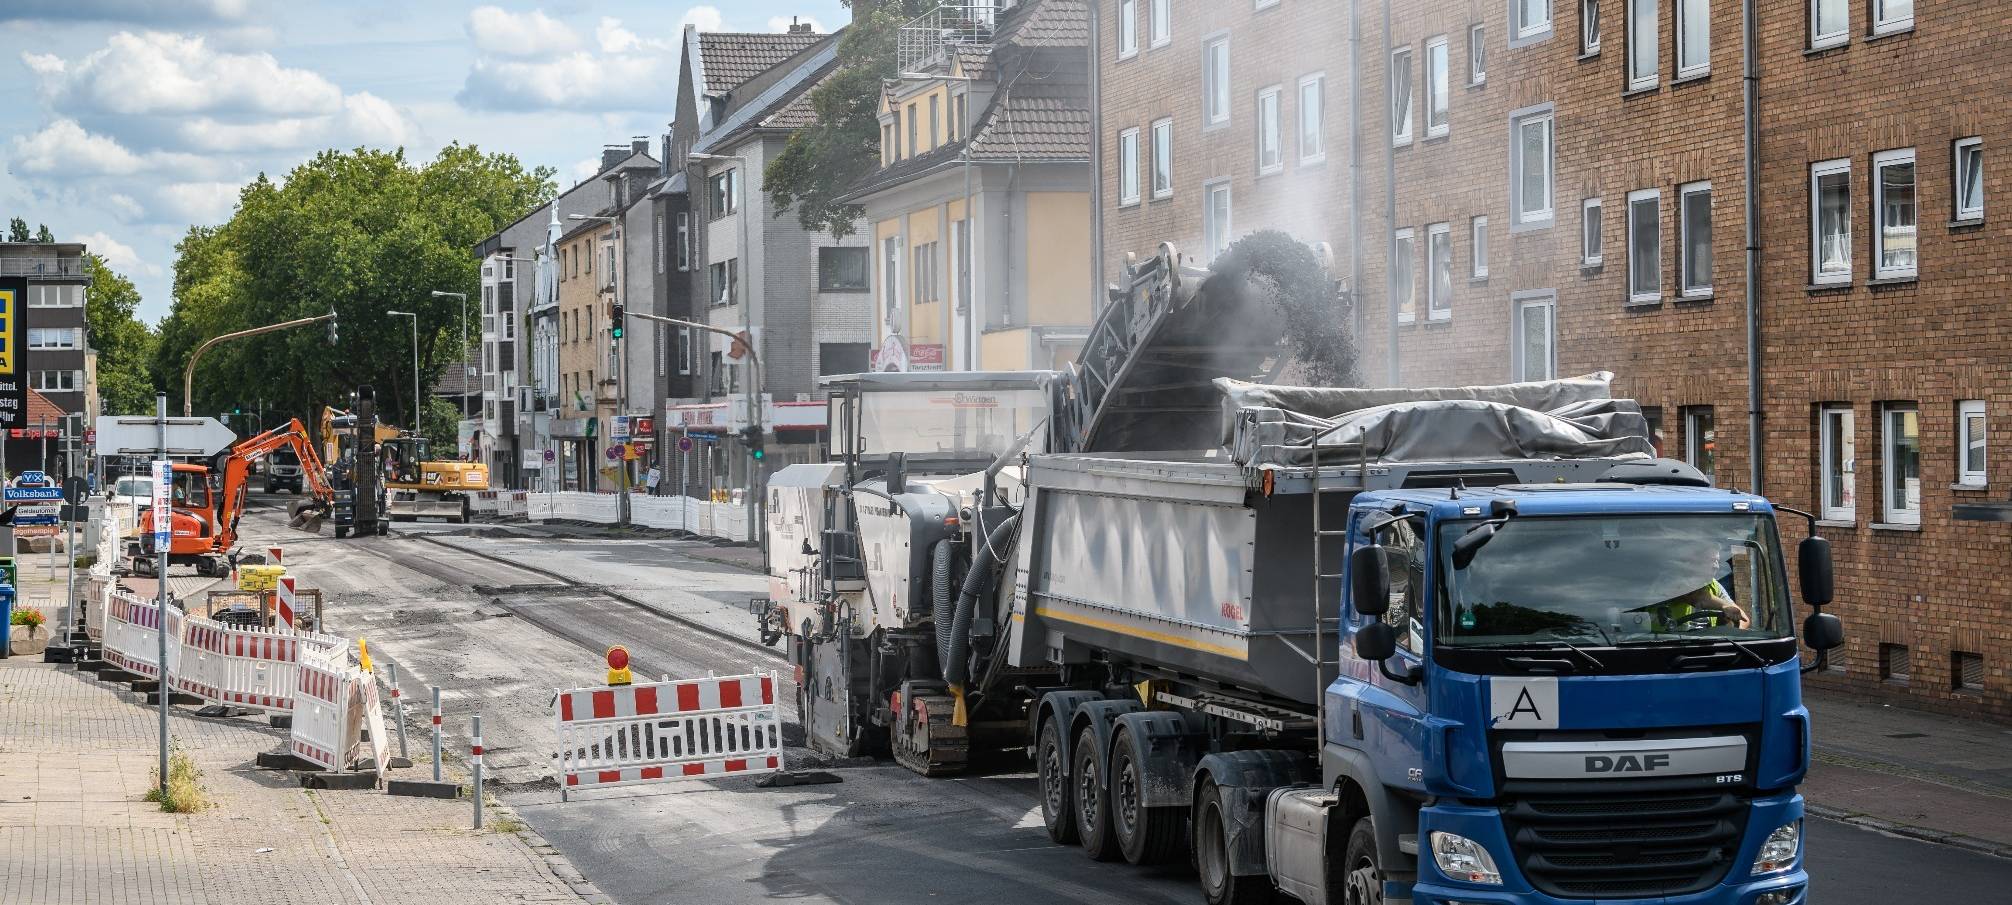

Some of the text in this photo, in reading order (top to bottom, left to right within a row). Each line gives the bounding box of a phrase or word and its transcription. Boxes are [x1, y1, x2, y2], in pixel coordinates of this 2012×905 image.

[7, 489, 60, 499] Volksbank
[1508, 685, 1542, 720] A
[1585, 754, 1670, 773] DAF
[1716, 774, 1742, 783] BTS
